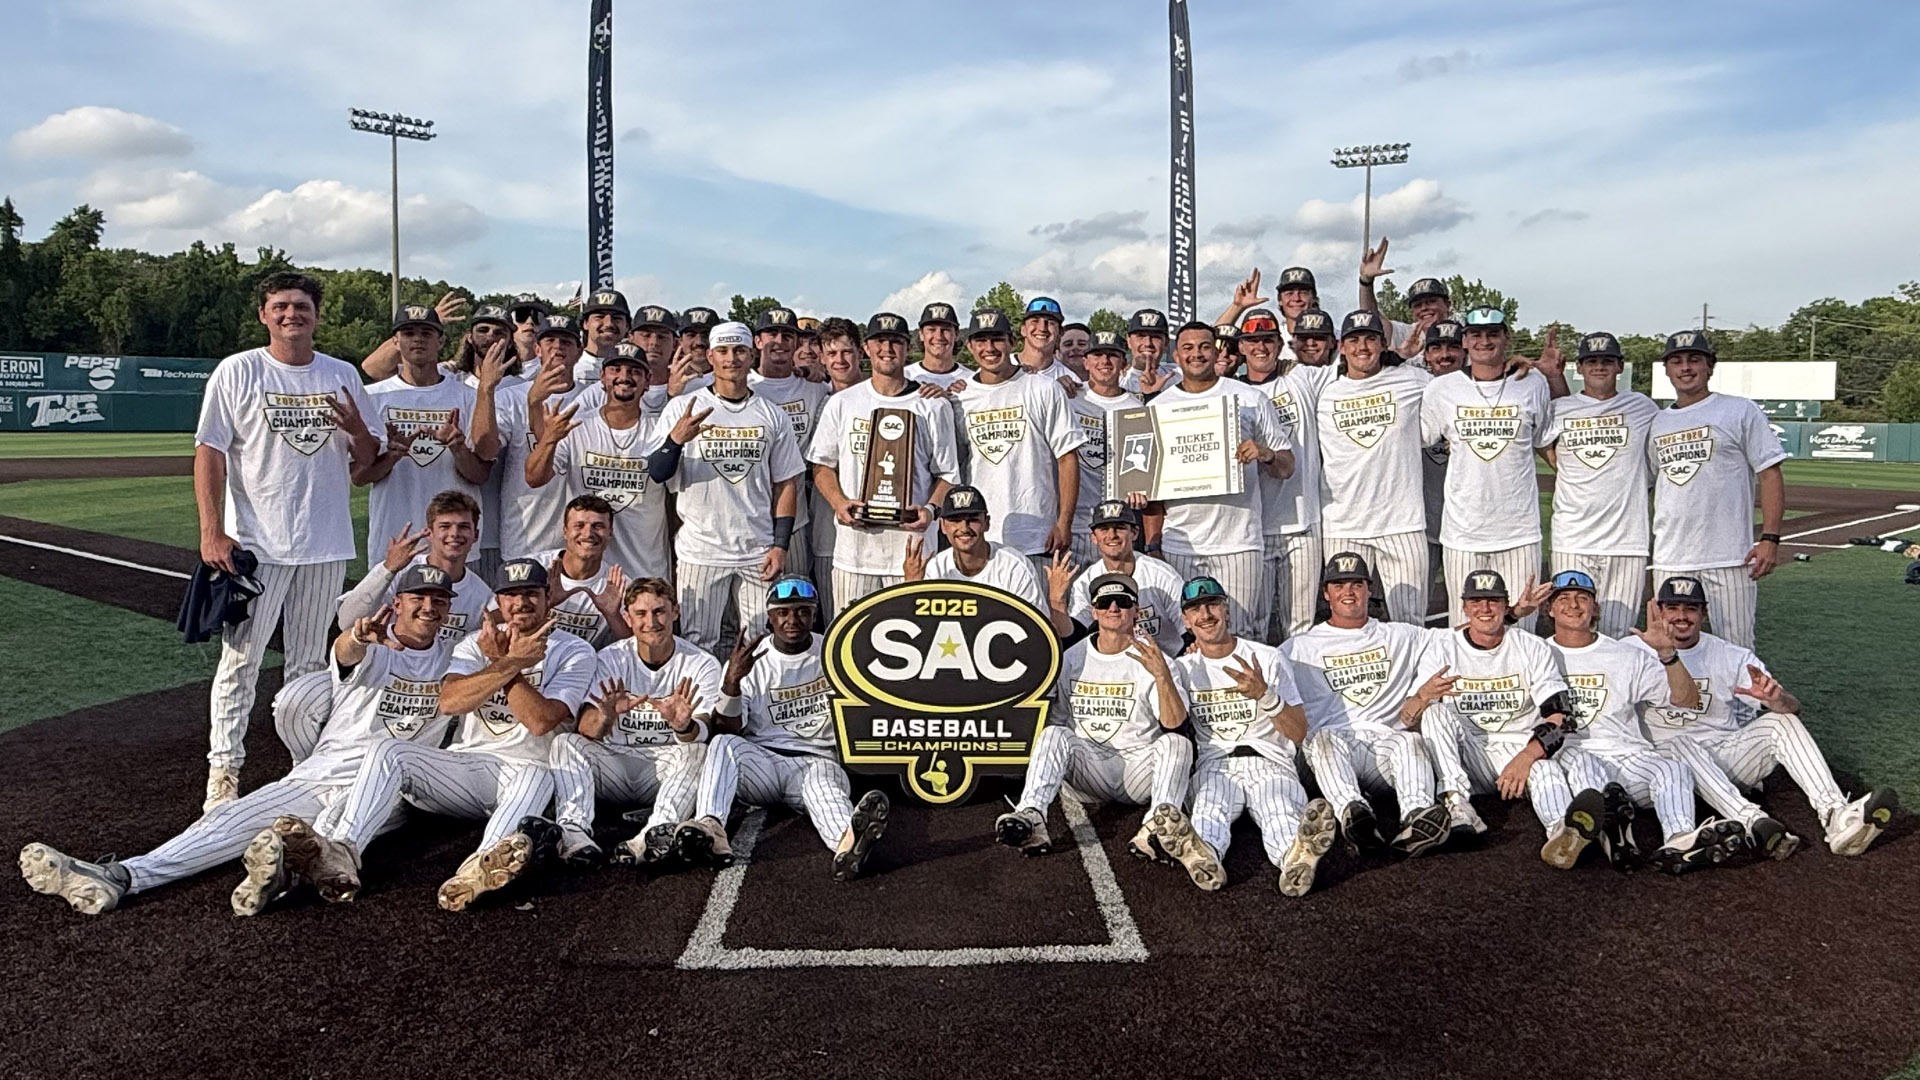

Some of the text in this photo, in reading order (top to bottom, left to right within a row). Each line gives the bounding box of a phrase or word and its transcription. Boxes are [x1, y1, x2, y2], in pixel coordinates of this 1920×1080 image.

[596, 291, 616, 305] W
[405, 306, 428, 320] W
[643, 308, 666, 322] W
[690, 309, 710, 323] W
[768, 310, 791, 323] W
[929, 306, 950, 319] W
[547, 316, 569, 328] W
[877, 316, 900, 330] W
[976, 313, 998, 328] W
[1139, 313, 1160, 326] W
[1302, 314, 1323, 328] W
[1351, 313, 1372, 327] W
[1437, 323, 1457, 337] W
[1096, 332, 1116, 344] W
[1587, 337, 1610, 351] W
[1673, 334, 1696, 347] W
[615, 344, 638, 358] W
[65, 356, 120, 370] PEPSI
[275, 396, 325, 406] 2025-202
[883, 422, 902, 430] SAC
[1339, 413, 1391, 428] CHAMPIONS
[294, 433, 318, 443] SAC
[1176, 432, 1214, 444] TICKET
[1357, 429, 1377, 439] SAC
[1461, 428, 1514, 437] CHAMPIONS
[1170, 441, 1220, 455] PUNCHED
[1477, 441, 1498, 450] SAC
[1567, 436, 1623, 447] CHAMPIONS
[413, 446, 433, 455] SAC
[705, 449, 760, 458] CHAMPIONS
[1585, 450, 1606, 459] SAC
[1182, 453, 1209, 463] 2026
[724, 464, 744, 472] SAC
[1671, 466, 1690, 475] SAC
[587, 477, 644, 490] CHAMPIONS
[951, 492, 974, 508] W
[1100, 504, 1123, 519] W
[1335, 557, 1358, 573] W
[418, 568, 445, 583] W
[506, 563, 532, 581] W
[1472, 574, 1497, 591] W
[1670, 580, 1695, 595] W
[915, 599, 977, 616] 2026
[867, 618, 1028, 682] SAC
[1332, 671, 1386, 687] CHAMPIONS
[1197, 692, 1239, 702] 2025-202
[1353, 687, 1373, 696] SAC
[1074, 706, 1127, 717] CHAMPIONS
[1460, 700, 1519, 711] CHAMPIONS
[489, 711, 514, 723] SAC
[1480, 716, 1501, 724] SAC
[872, 719, 1012, 738] BASEBALL
[1091, 723, 1111, 732] SAC
[884, 741, 999, 751] CHAMPIONS
